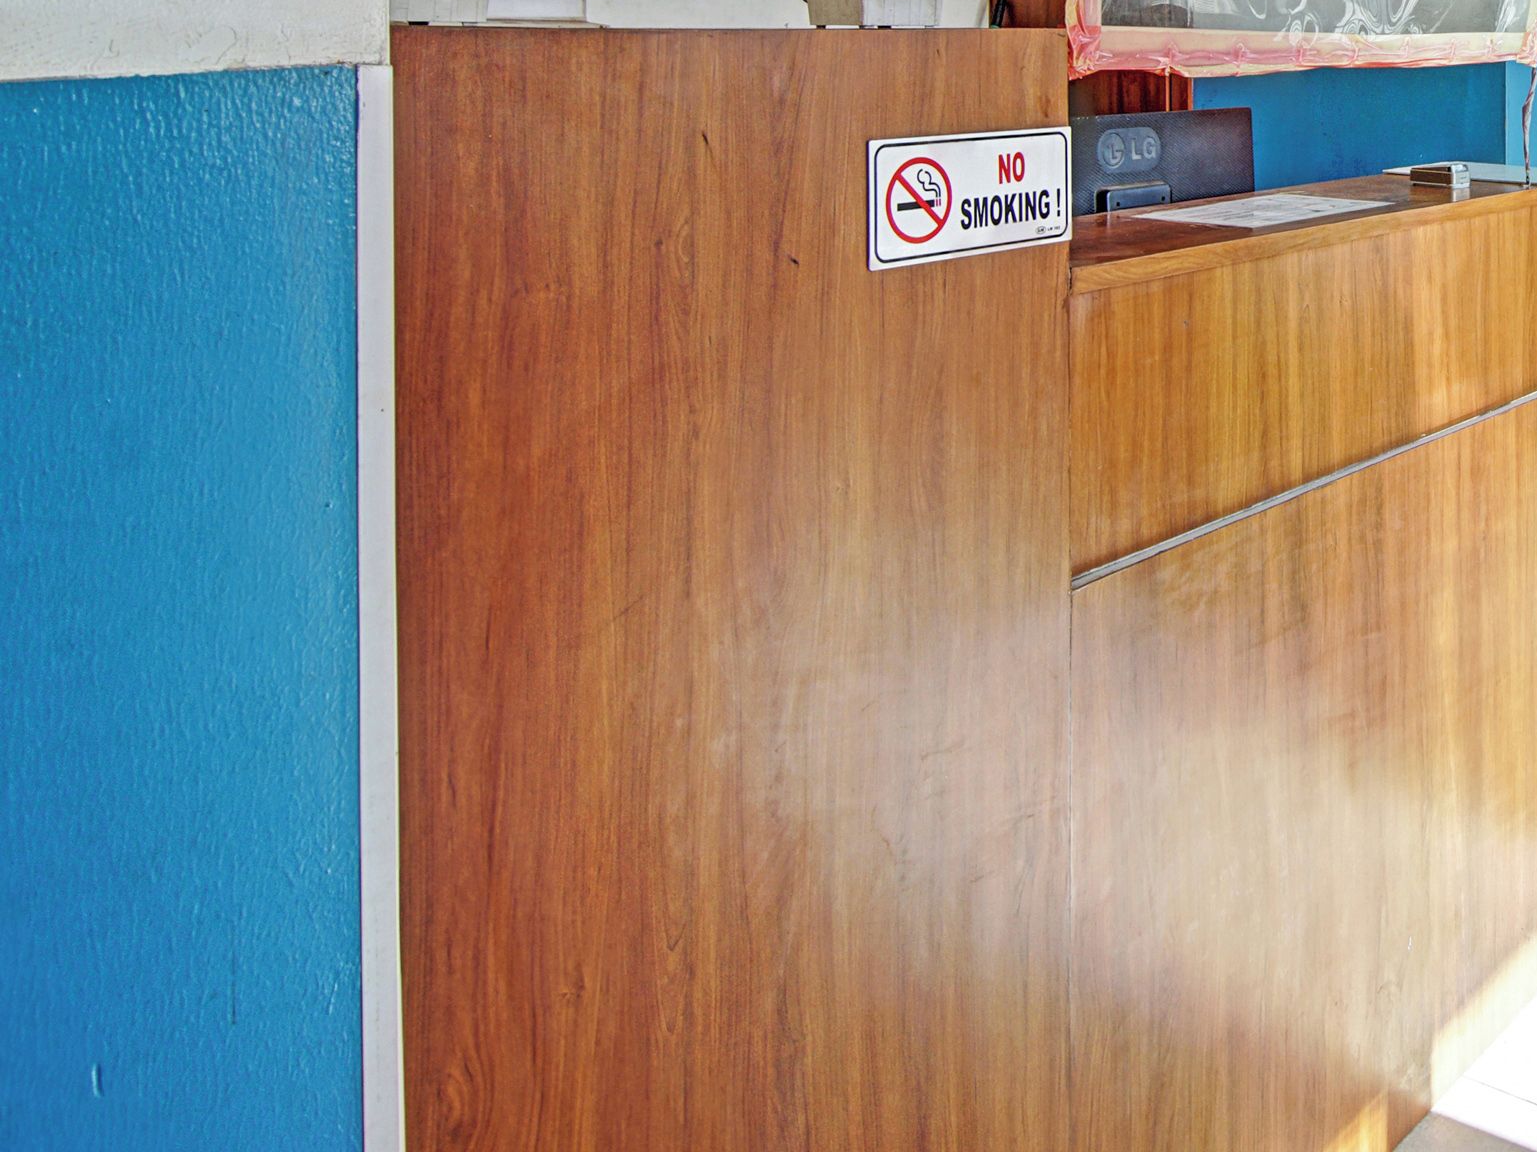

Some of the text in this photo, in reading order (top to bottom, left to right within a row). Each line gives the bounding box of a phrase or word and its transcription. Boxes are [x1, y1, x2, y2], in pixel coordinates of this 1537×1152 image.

[1131, 136, 1156, 160] LG
[998, 151, 1025, 184] NO
[960, 189, 1050, 230] SMOKING
